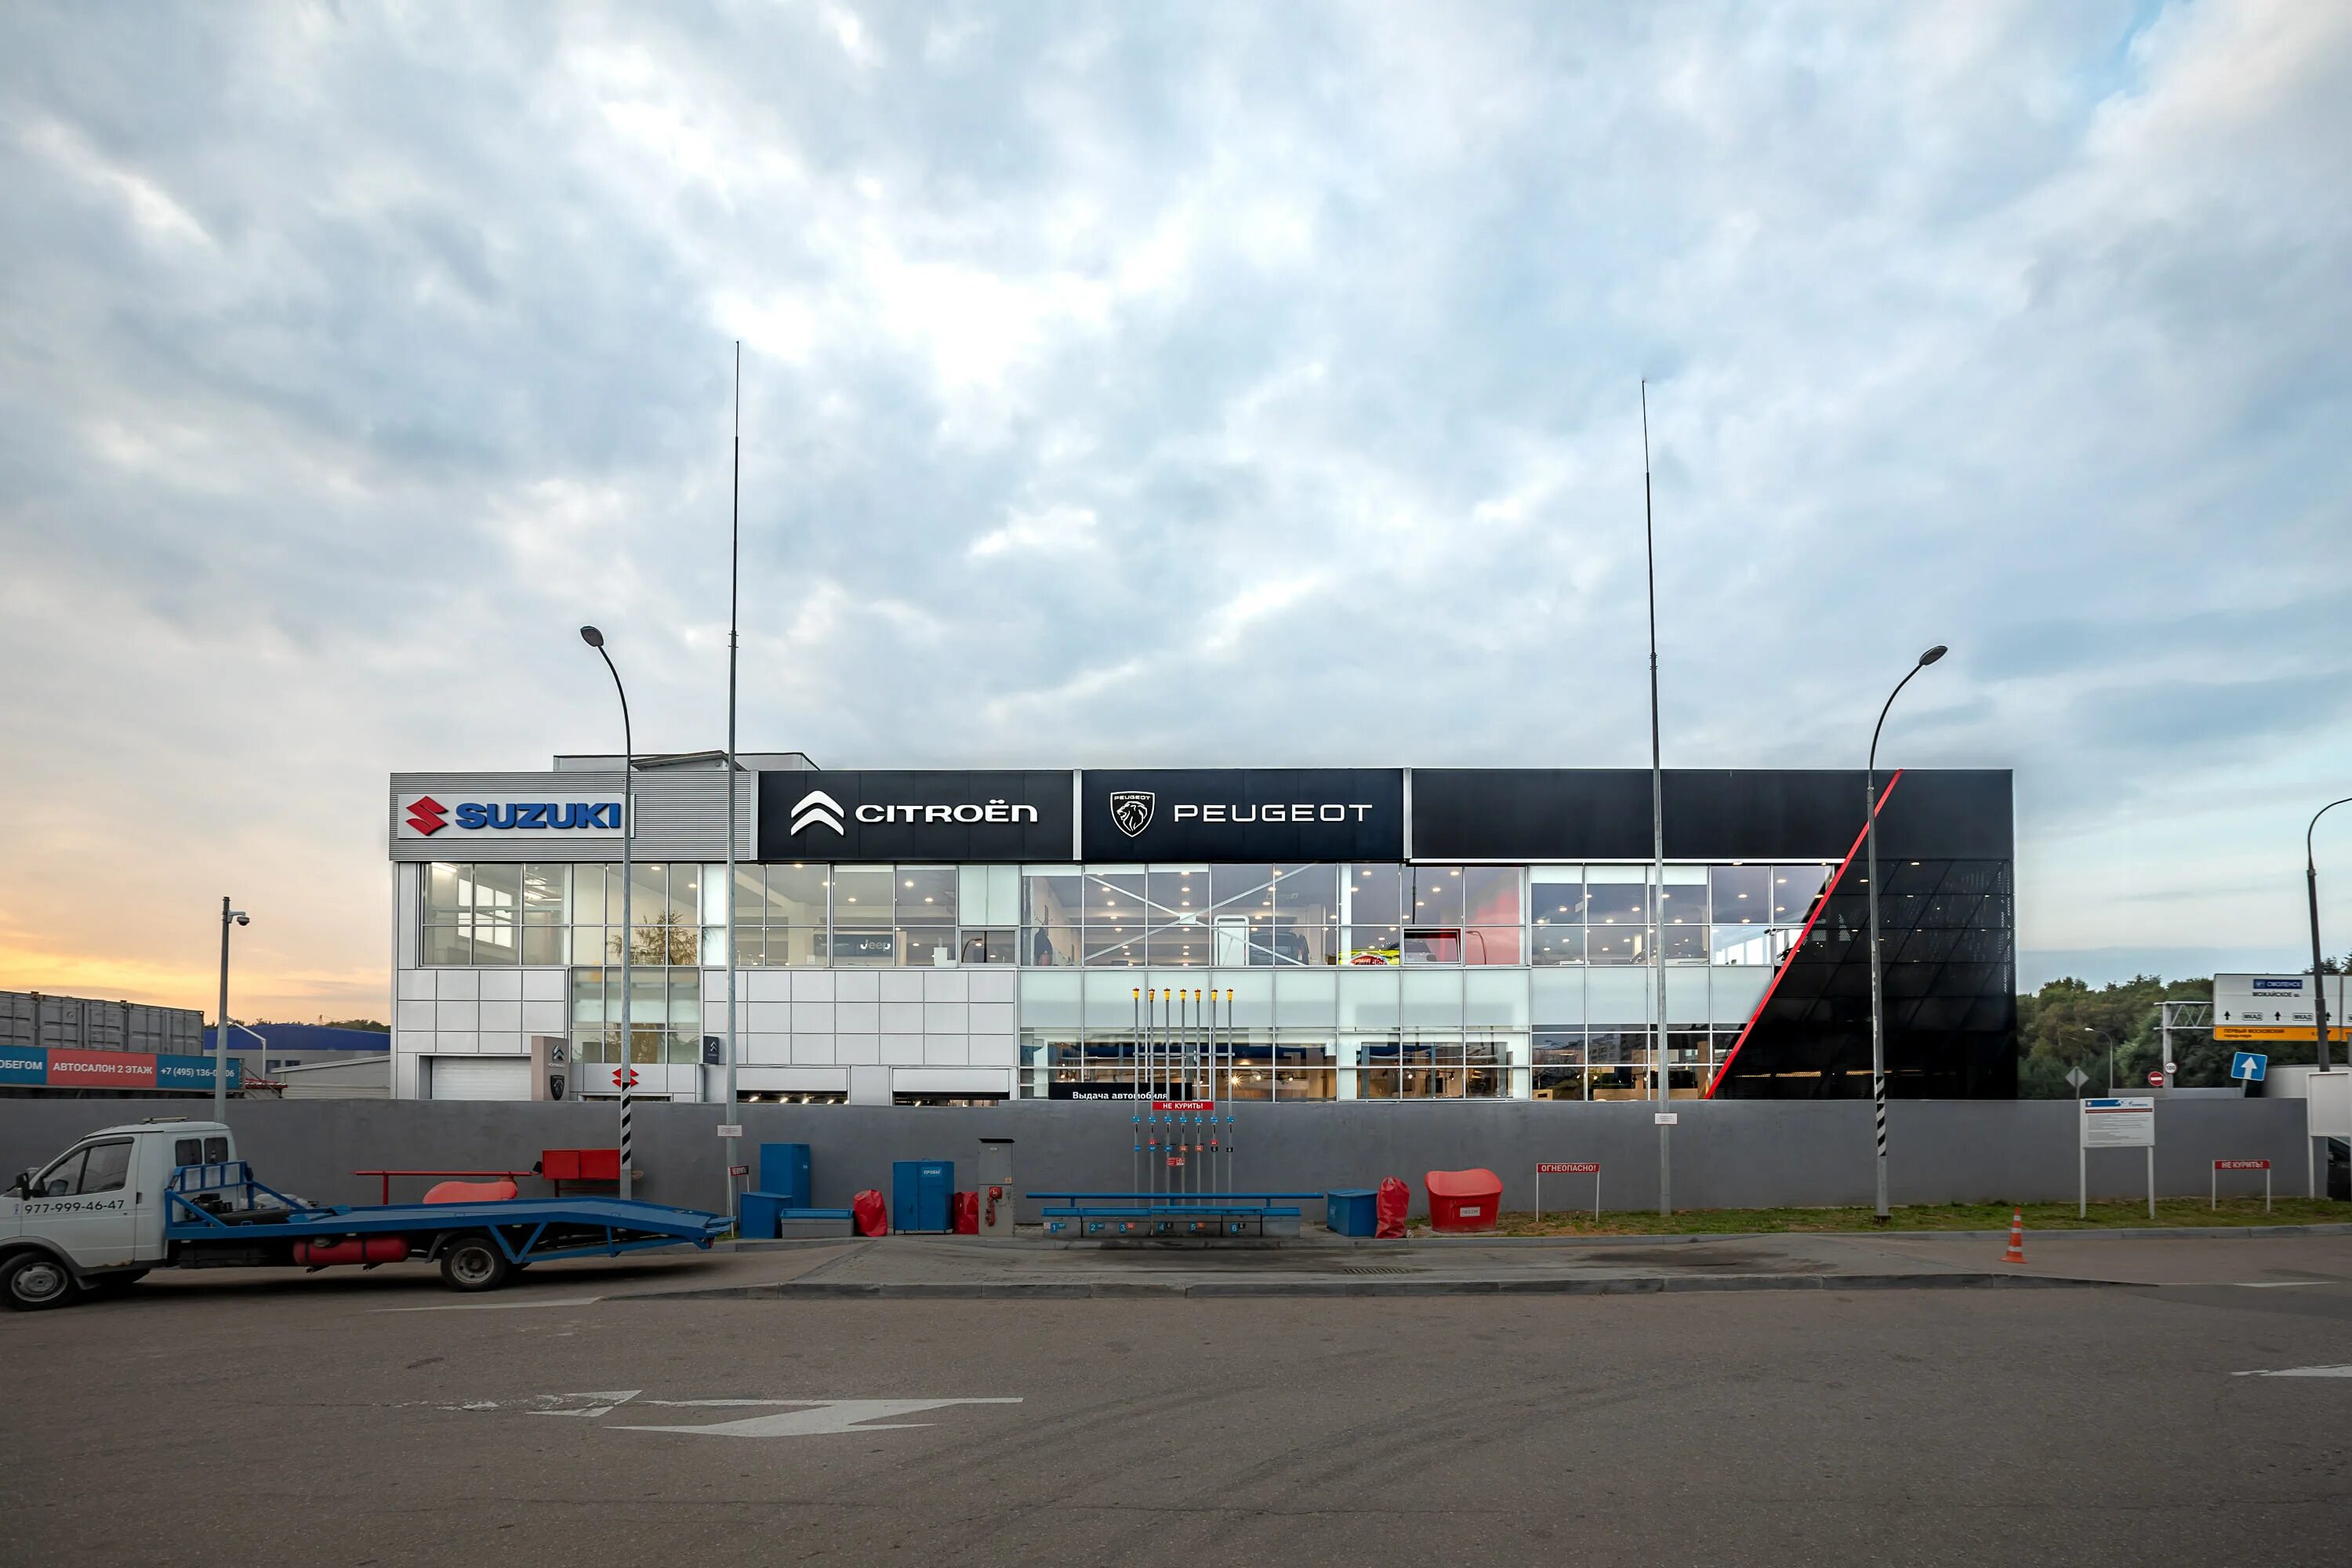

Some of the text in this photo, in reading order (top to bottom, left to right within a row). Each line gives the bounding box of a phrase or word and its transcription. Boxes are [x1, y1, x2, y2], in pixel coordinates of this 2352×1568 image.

[455, 802, 622, 829] SUZUKI
[1174, 804, 1373, 822] PEUGEOT
[859, 938, 891, 952] Jeep
[53, 1062, 152, 1075] АВТОСАЛОН 2 ЭТАЖ
[161, 1067, 234, 1078] +7 (495) 136-006
[1073, 1091, 1109, 1101] Выдача
[24, 1200, 125, 1214] 977-999-46-47
